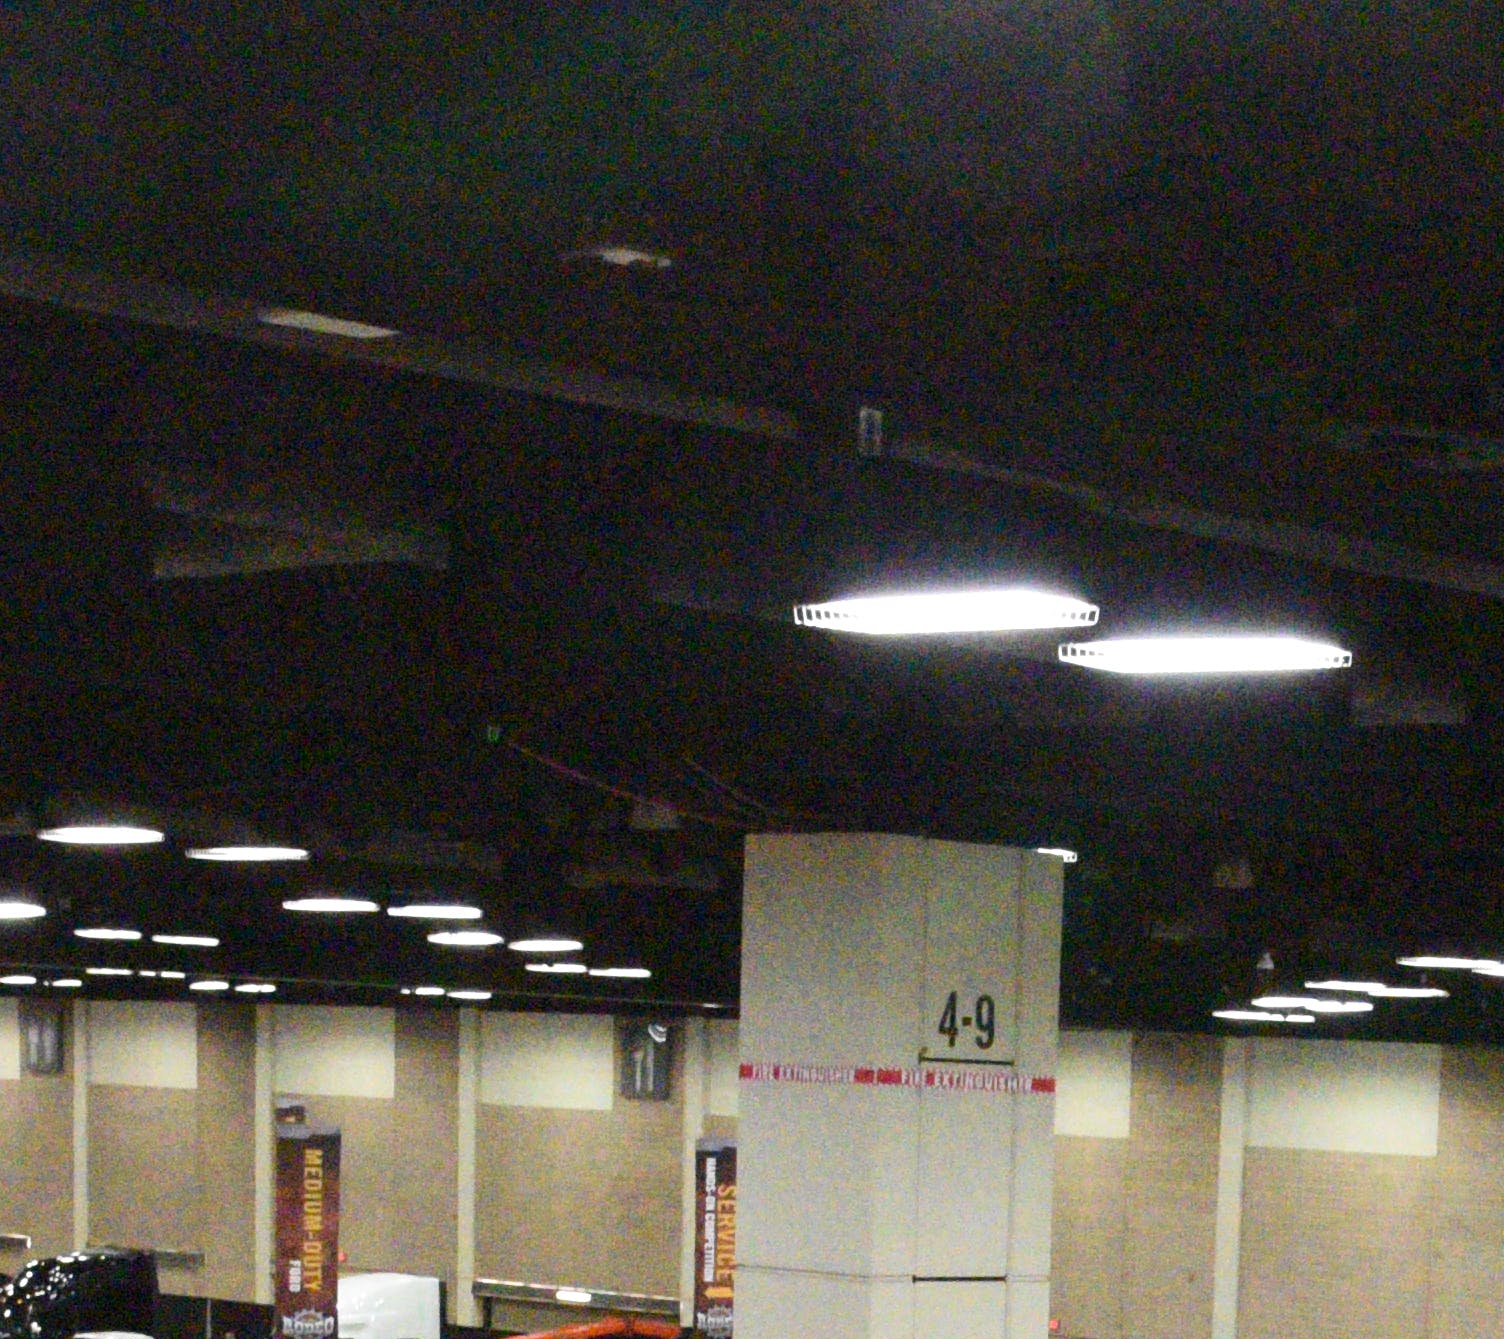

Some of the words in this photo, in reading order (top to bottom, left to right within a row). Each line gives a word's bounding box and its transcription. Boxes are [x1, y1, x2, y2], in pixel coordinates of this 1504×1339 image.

[938, 990, 996, 1050] 4-9
[303, 1148, 323, 1291] MEDIUM-DUTY
[716, 1183, 736, 1283] SERVICE
